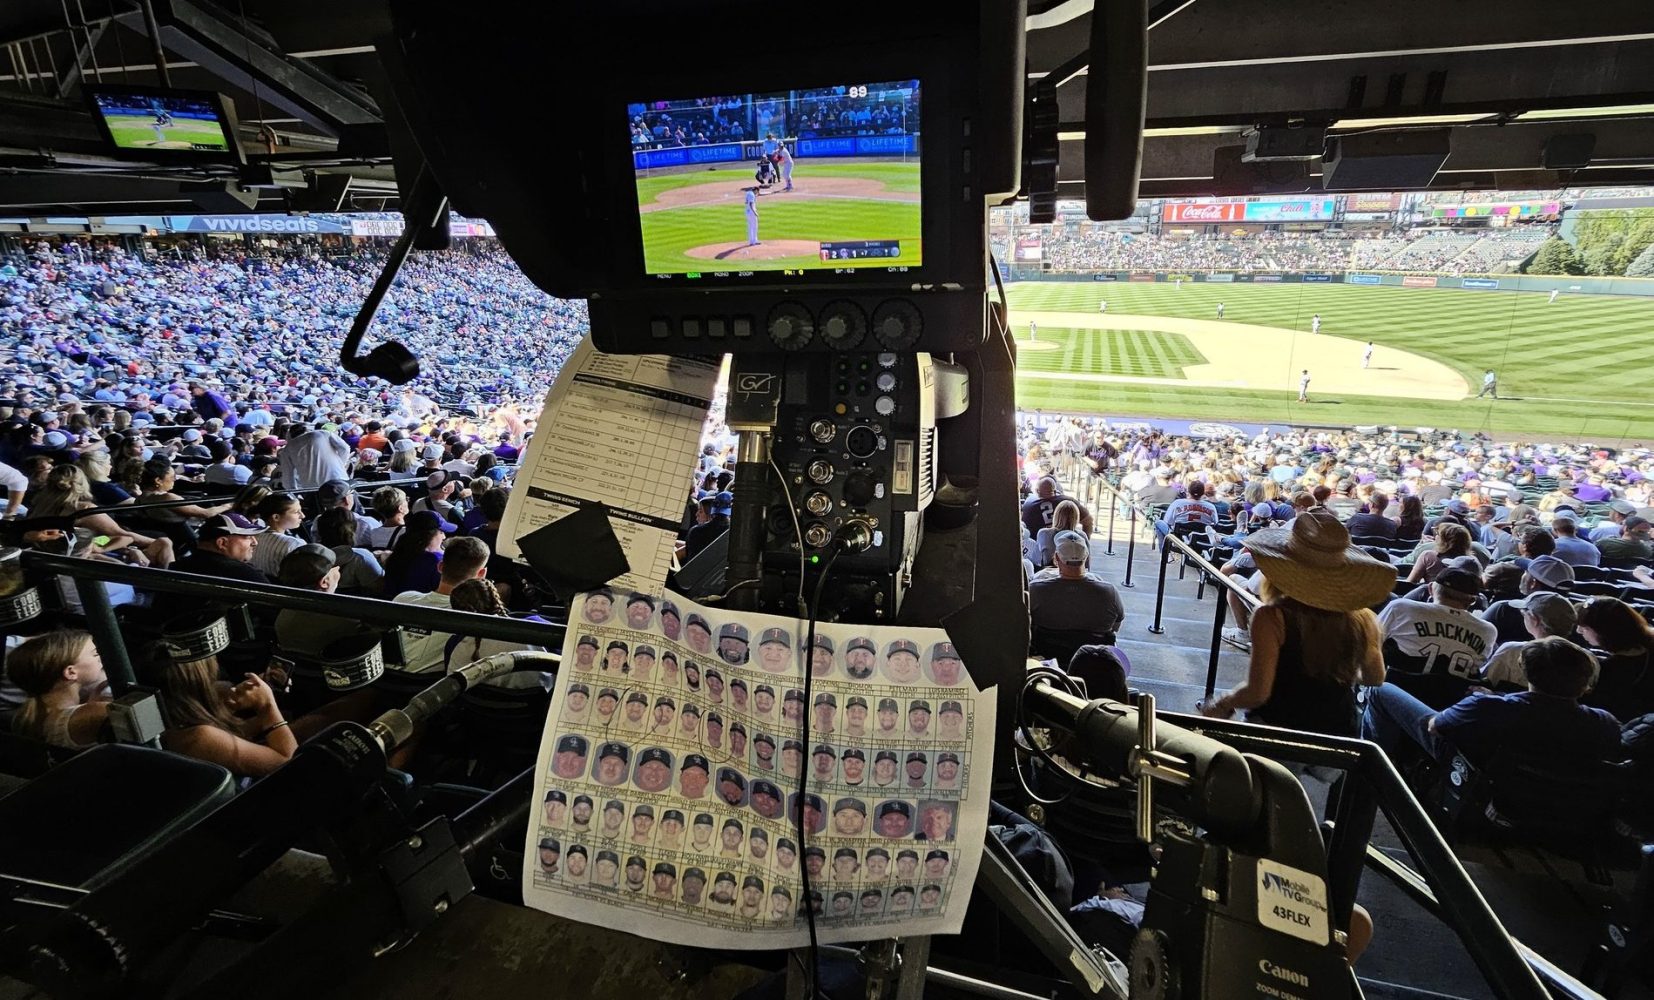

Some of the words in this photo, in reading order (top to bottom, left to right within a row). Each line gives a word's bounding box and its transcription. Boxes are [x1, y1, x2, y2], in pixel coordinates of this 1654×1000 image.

[849, 86, 867, 98] 89
[868, 137, 909, 146] LIFETIME
[702, 147, 737, 156] LIFETIME
[1181, 205, 1223, 219] Coca-Cola
[203, 215, 319, 232] vividseats
[609, 508, 627, 517] TWINS
[627, 512, 653, 522] BULLPEN
[1414, 621, 1487, 655] BLACKMON
[1281, 878, 1310, 895] Mobile
[1273, 905, 1311, 927] 43FLEX
[1259, 959, 1309, 987] Canon
[1256, 982, 1279, 997] ZOOM
